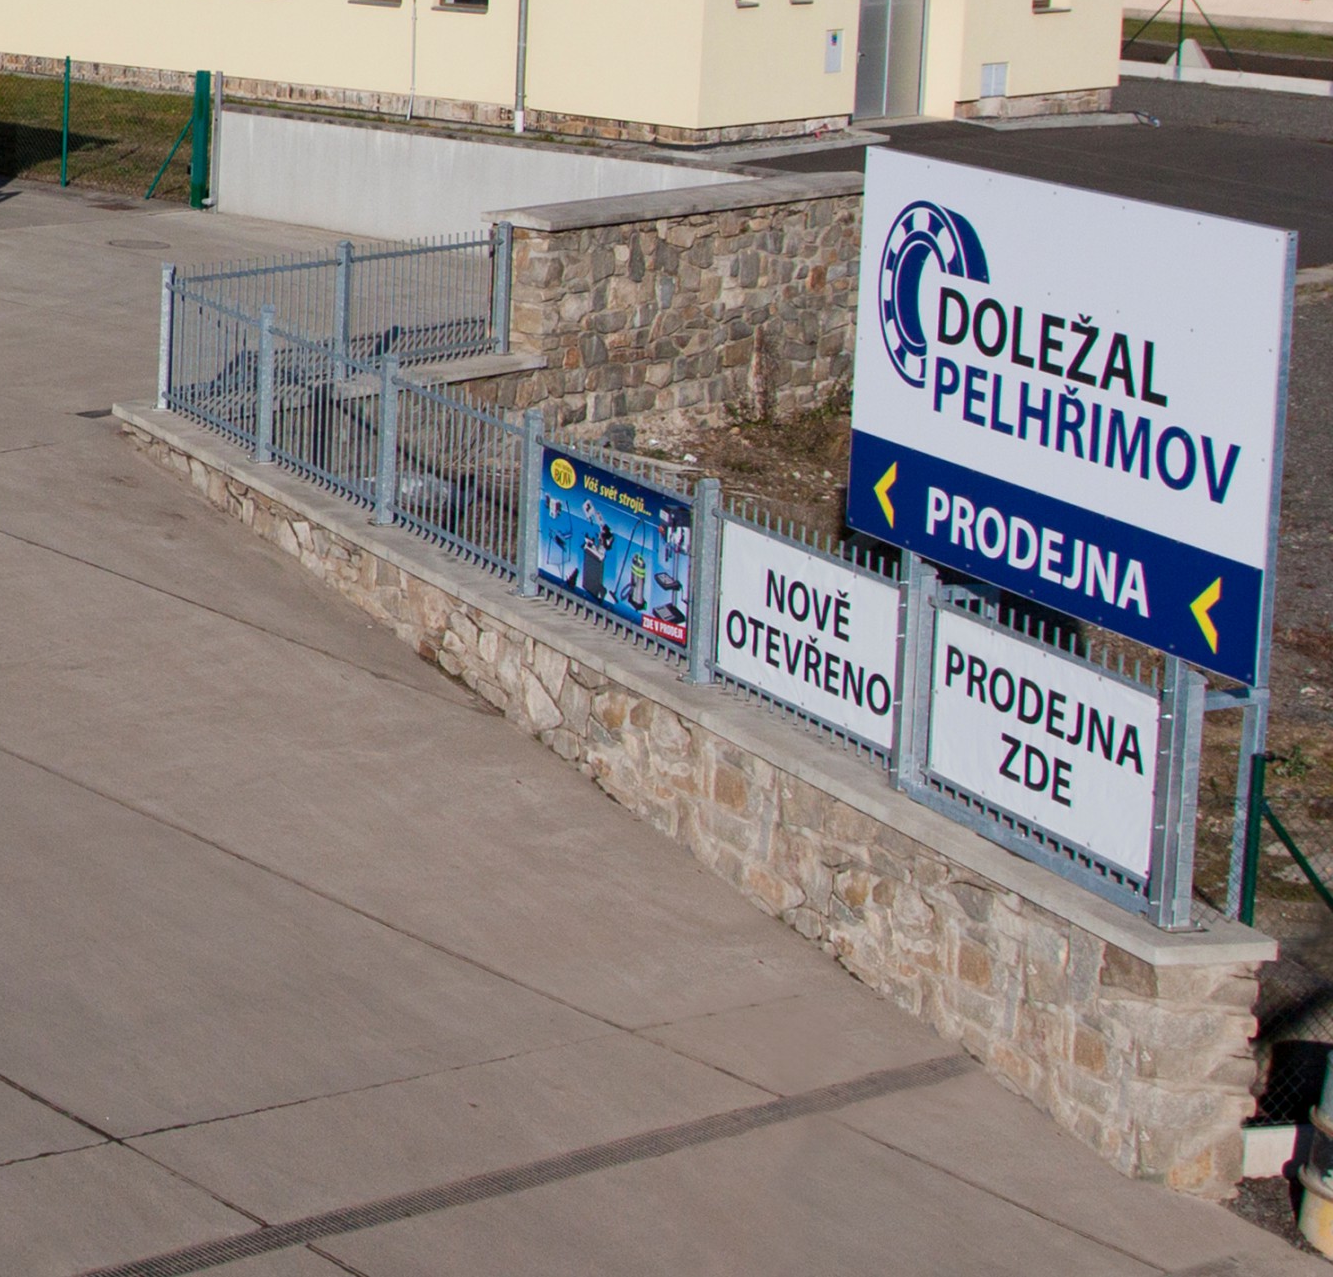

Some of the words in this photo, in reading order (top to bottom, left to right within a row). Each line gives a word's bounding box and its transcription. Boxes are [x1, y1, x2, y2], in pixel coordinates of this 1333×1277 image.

[936, 285, 1168, 407] DOLEŽAL
[584, 474, 599, 493] Váš
[600, 485, 618, 501] svět
[932, 355, 1242, 505] PELHŘIMOV
[765, 568, 851, 642] NOVĚ
[925, 485, 1151, 618] PRODEJNA
[726, 608, 892, 717] OTEVŘENO
[945, 644, 1145, 775] PRODEJNA
[999, 732, 1073, 807] ZDE
